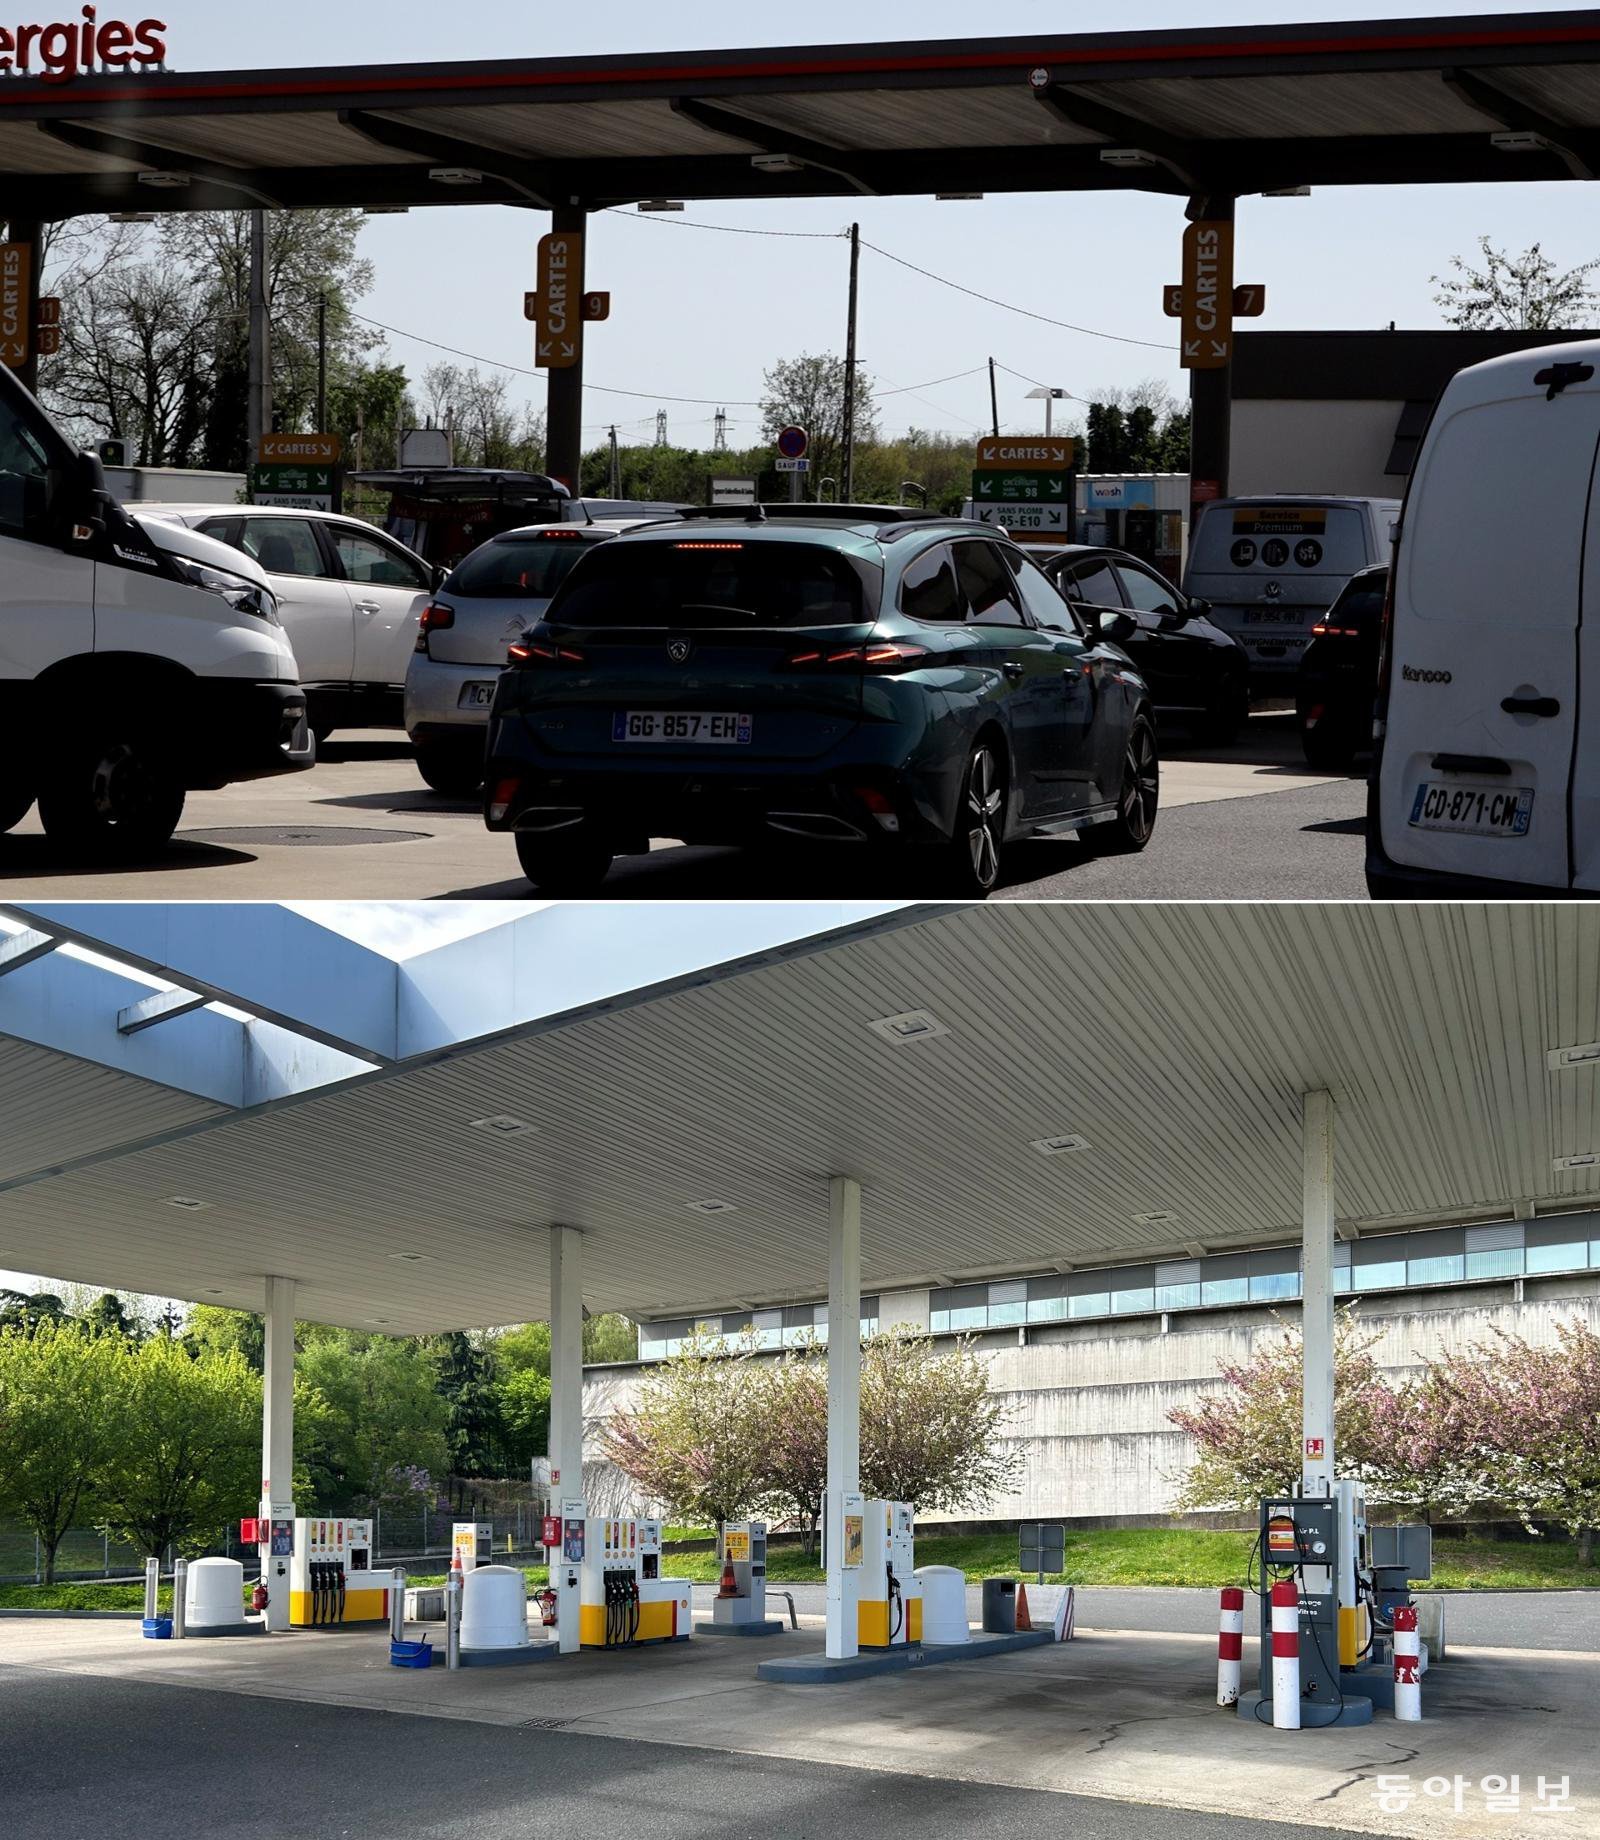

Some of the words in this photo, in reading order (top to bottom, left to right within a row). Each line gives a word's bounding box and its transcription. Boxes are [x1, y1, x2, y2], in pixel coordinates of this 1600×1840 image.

[547, 241, 568, 334] CARTES
[1195, 229, 1219, 331] CARTES
[3, 250, 20, 336] CARTES
[1242, 290, 1256, 311] 7
[40, 302, 54, 320] 11
[590, 296, 602, 316] 9
[37, 331, 54, 350] 13
[277, 443, 318, 454] CARTES
[999, 447, 1049, 459] CARTES
[1024, 487, 1038, 497] 98
[1095, 486, 1122, 497] wash
[999, 516, 1041, 527] 95-E10
[1254, 522, 1303, 533] Premium
[629, 715, 736, 738] GG-857-EH
[1424, 789, 1518, 826] CD-871-CM
